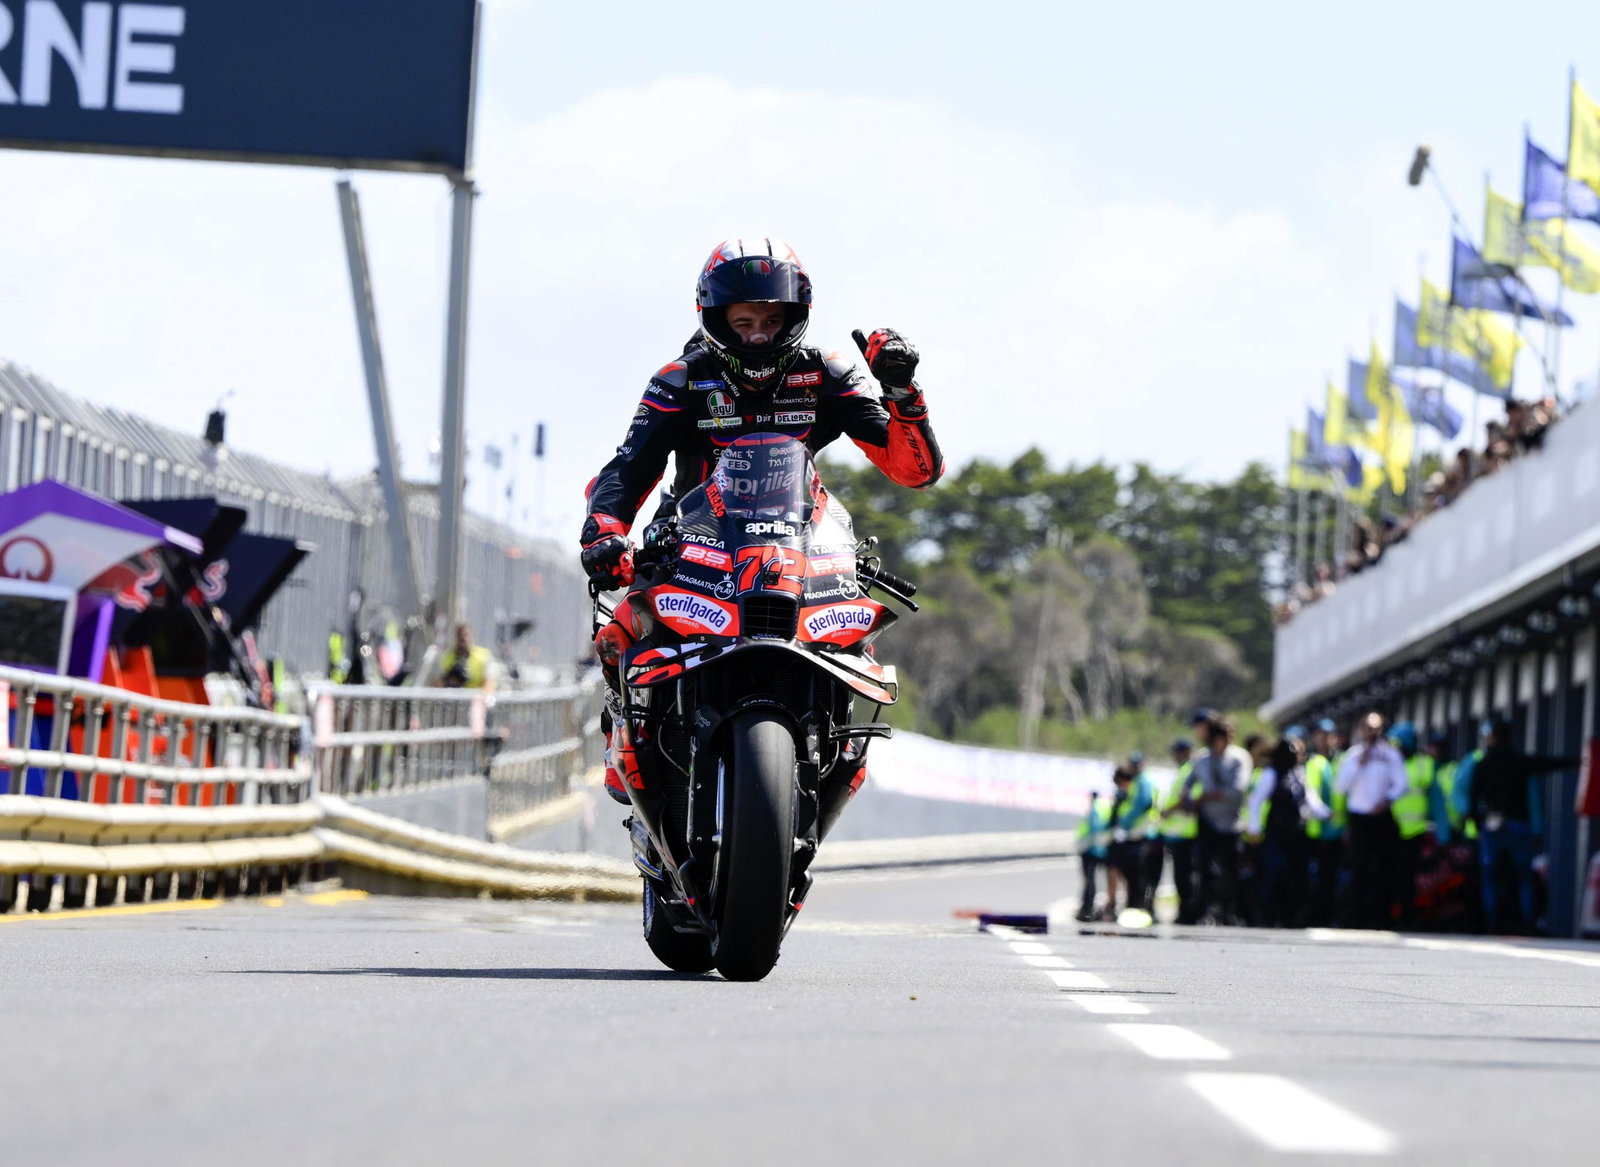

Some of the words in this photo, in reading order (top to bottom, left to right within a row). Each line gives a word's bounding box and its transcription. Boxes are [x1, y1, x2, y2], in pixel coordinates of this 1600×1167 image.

[743, 367, 775, 379] aprilia
[787, 372, 819, 384] BS
[721, 371, 740, 397] aprilia
[727, 460, 748, 470] FES
[723, 470, 801, 497] aprilia
[745, 520, 796, 536] aprilia
[681, 533, 725, 550] TARGA
[682, 545, 729, 565] BS
[734, 544, 808, 597] 72
[810, 556, 852, 572] BS
[674, 573, 716, 590] PRAGMATIC
[716, 585, 734, 595] PLAY
[804, 590, 841, 600] PRAGMATIC
[842, 586, 858, 595] PLAY
[658, 596, 726, 628] sterilgarda
[676, 618, 700, 629] alimenti
[808, 608, 872, 634] sterilgarda
[830, 629, 853, 638] alimenti
